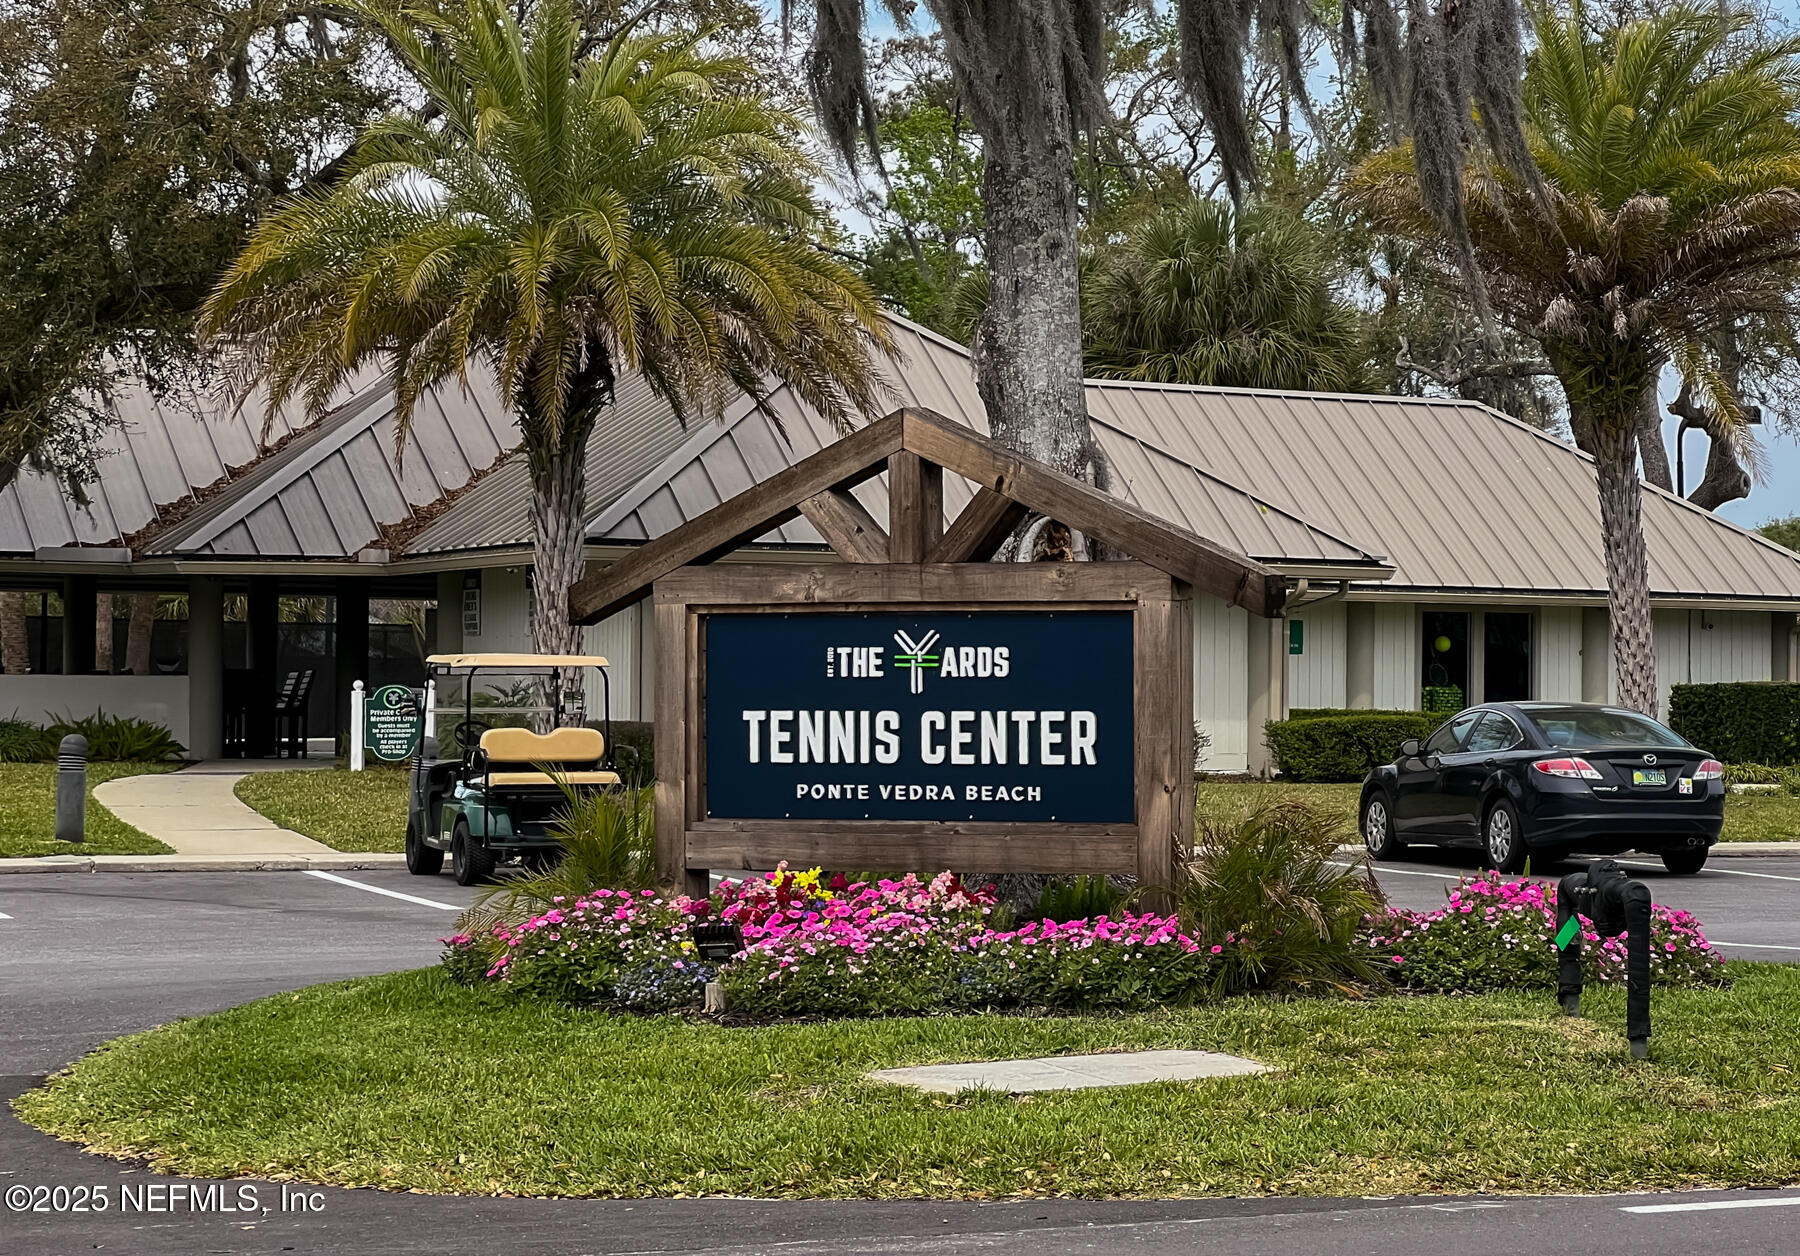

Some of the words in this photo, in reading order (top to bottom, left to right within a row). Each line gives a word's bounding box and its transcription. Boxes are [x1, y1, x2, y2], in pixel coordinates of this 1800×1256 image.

[837, 646, 884, 678] THE
[894, 629, 1010, 694] YARDS
[742, 710, 901, 764] TENNIS
[920, 710, 1098, 767] CENTER
[796, 783, 870, 800] PONTE
[879, 784, 956, 801] VEDRA
[966, 785, 1042, 802] BEACH
